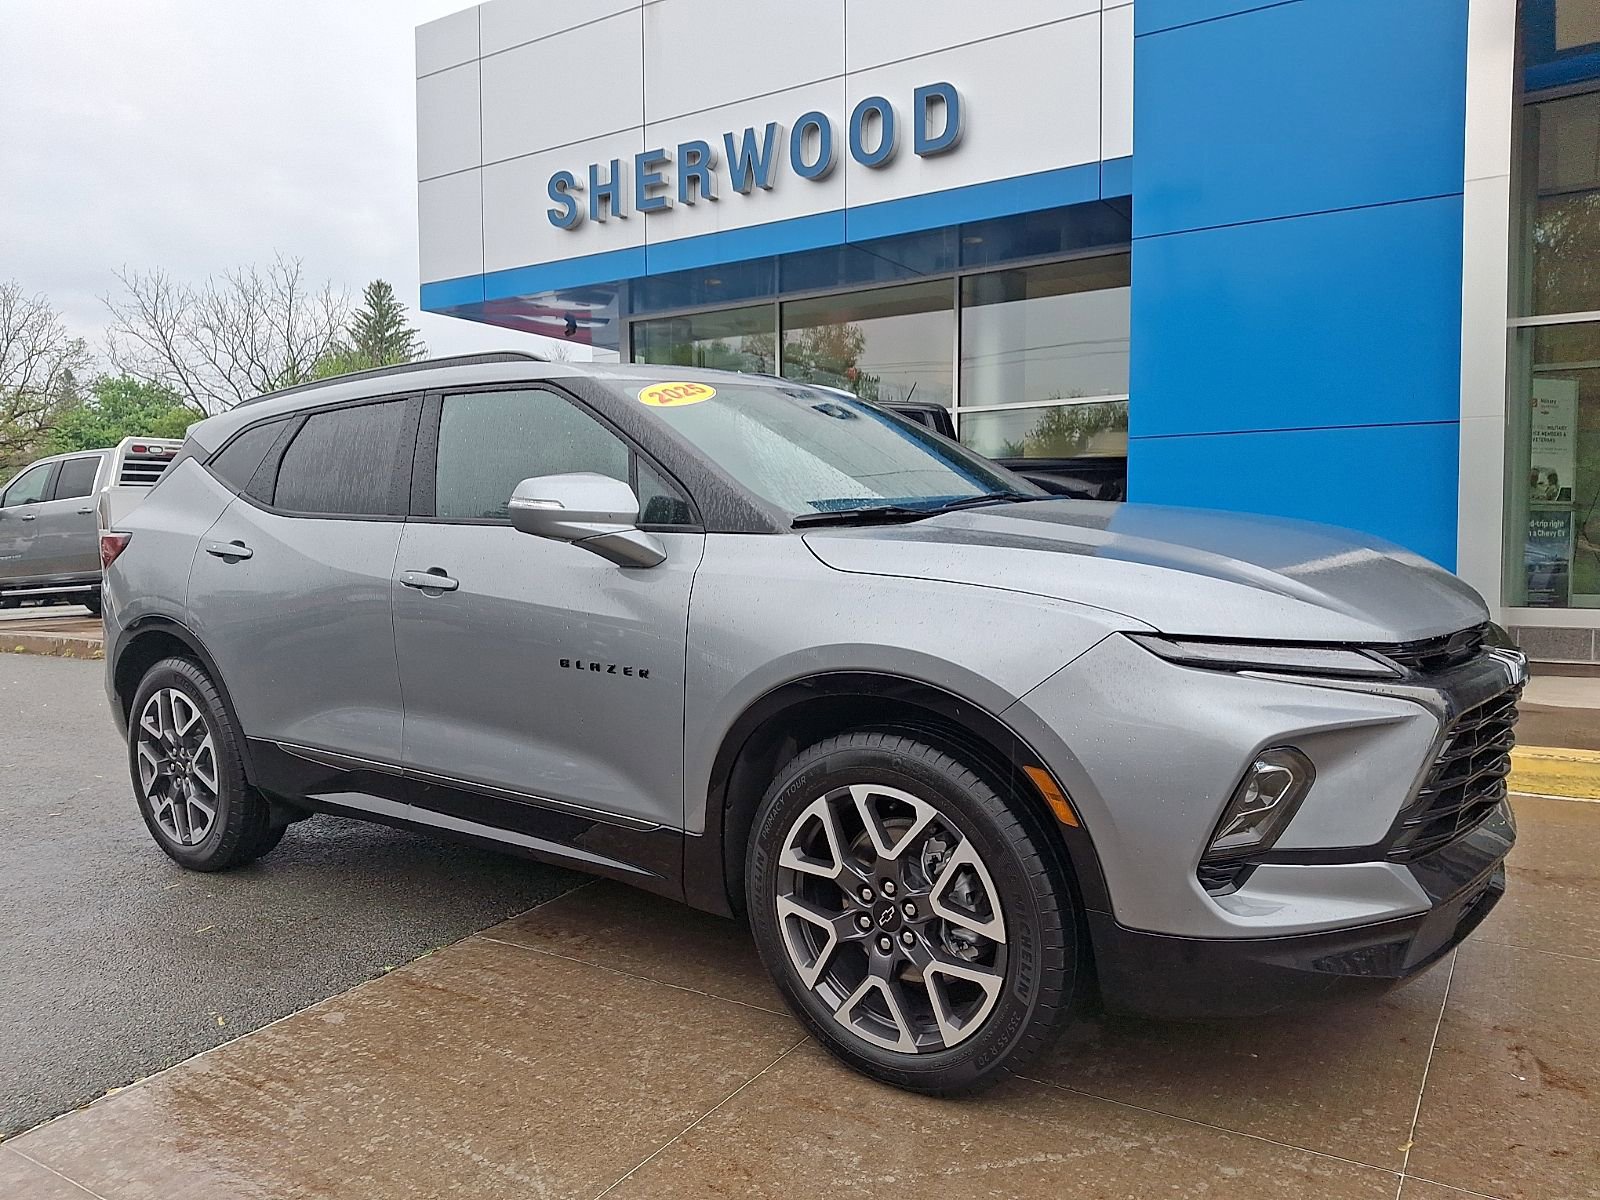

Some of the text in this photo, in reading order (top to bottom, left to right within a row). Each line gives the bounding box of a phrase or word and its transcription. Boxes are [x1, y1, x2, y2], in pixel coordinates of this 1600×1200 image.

[546, 81, 965, 231] SHERWOOD
[648, 384, 706, 404] 2025
[1537, 529, 1557, 538] Chevy
[1549, 520, 1564, 528] right
[559, 659, 649, 679] BLAZER
[761, 775, 807, 840] PRIMACY TOUR
